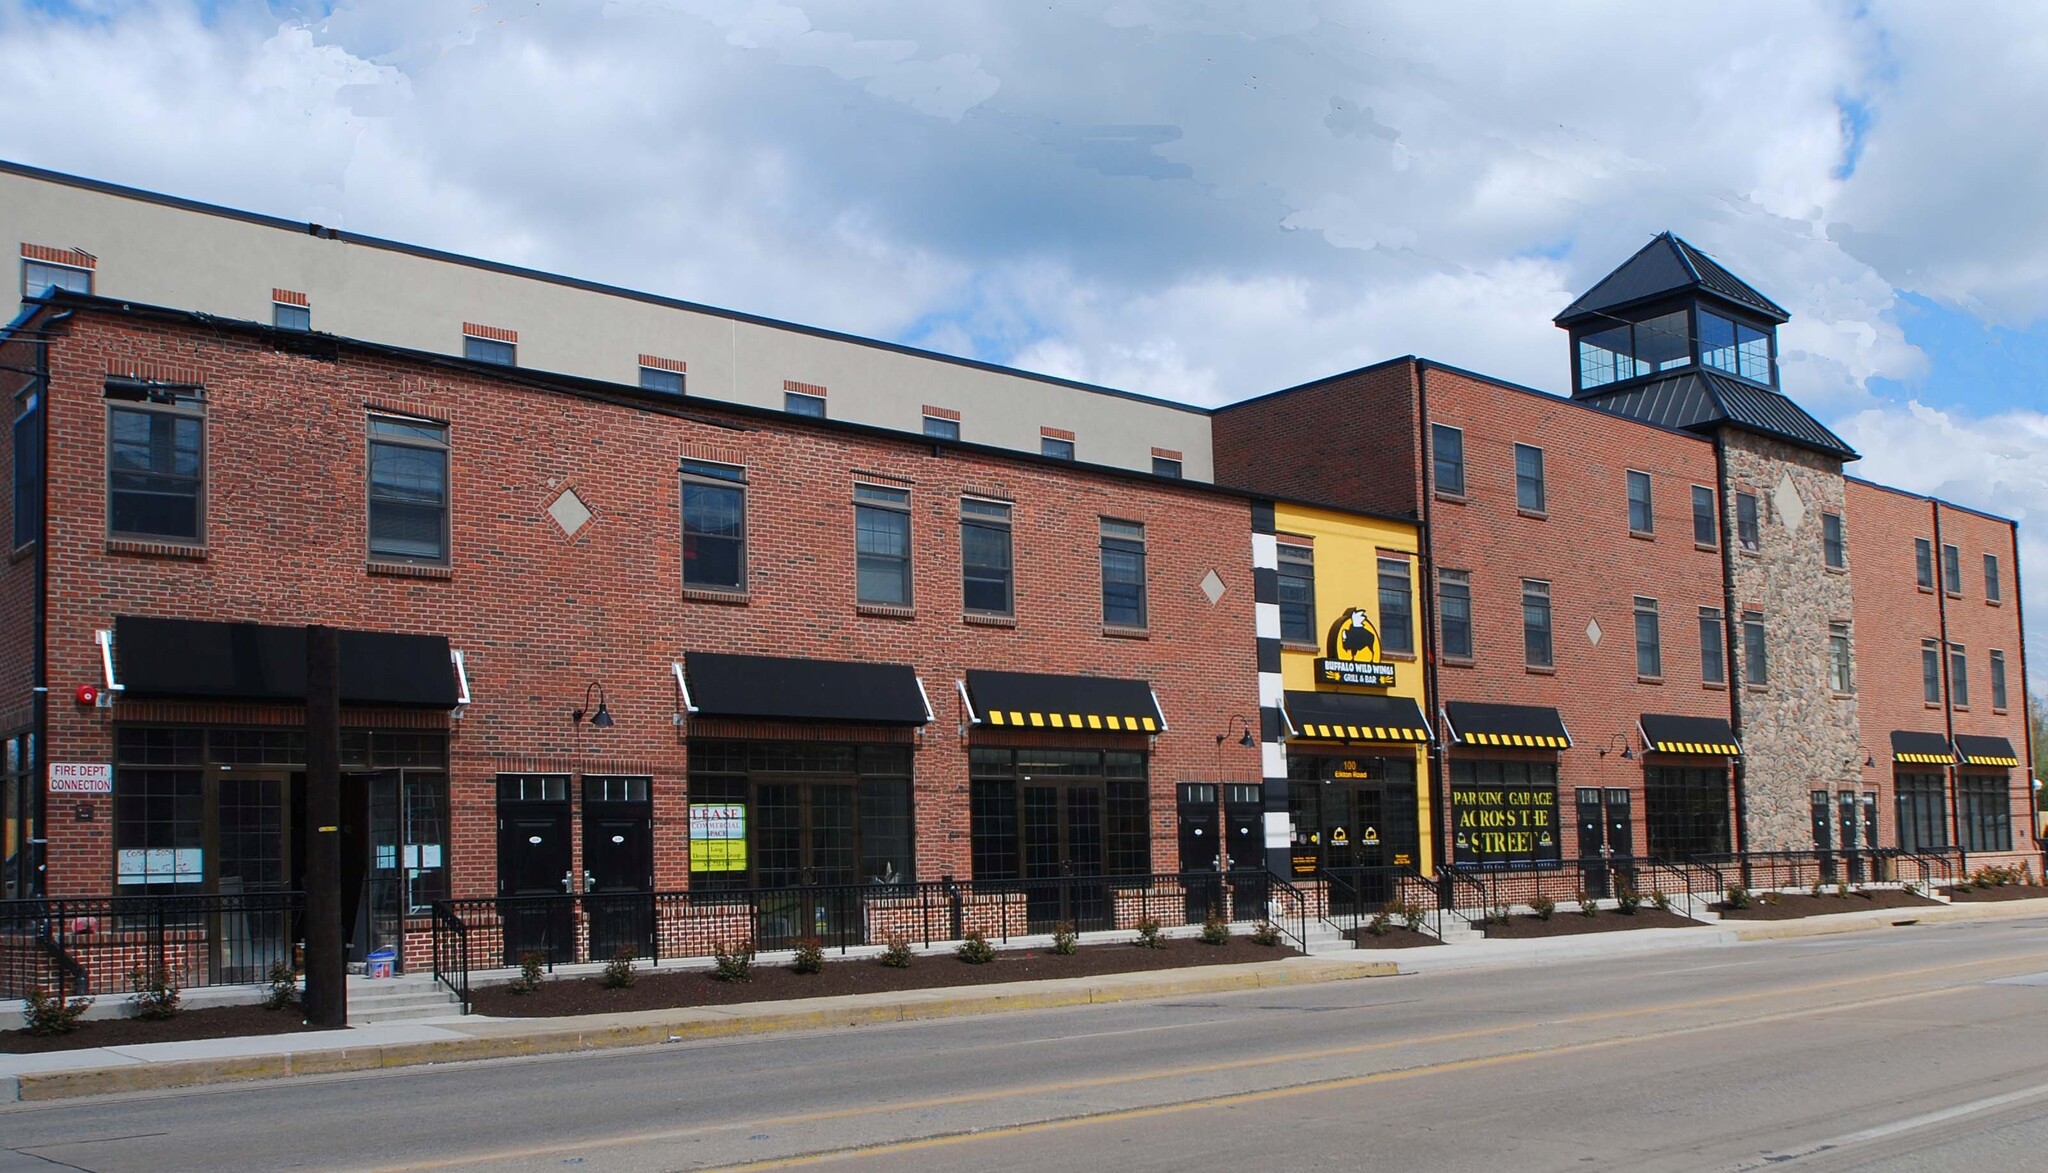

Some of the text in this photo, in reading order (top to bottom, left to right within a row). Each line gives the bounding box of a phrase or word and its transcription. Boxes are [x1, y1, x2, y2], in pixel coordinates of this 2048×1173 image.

[1324, 660, 1394, 675] BUFFALO WILD WINGS
[1343, 673, 1377, 684] GRILL & BAR
[55, 765, 107, 776] FIRE DEPT.
[1343, 761, 1356, 770] 100
[51, 779, 110, 791] CONNECTION
[1453, 791, 1553, 805] PARKING GARAGE
[692, 809, 738, 819] LEASE
[1459, 810, 1516, 827] ACROSS
